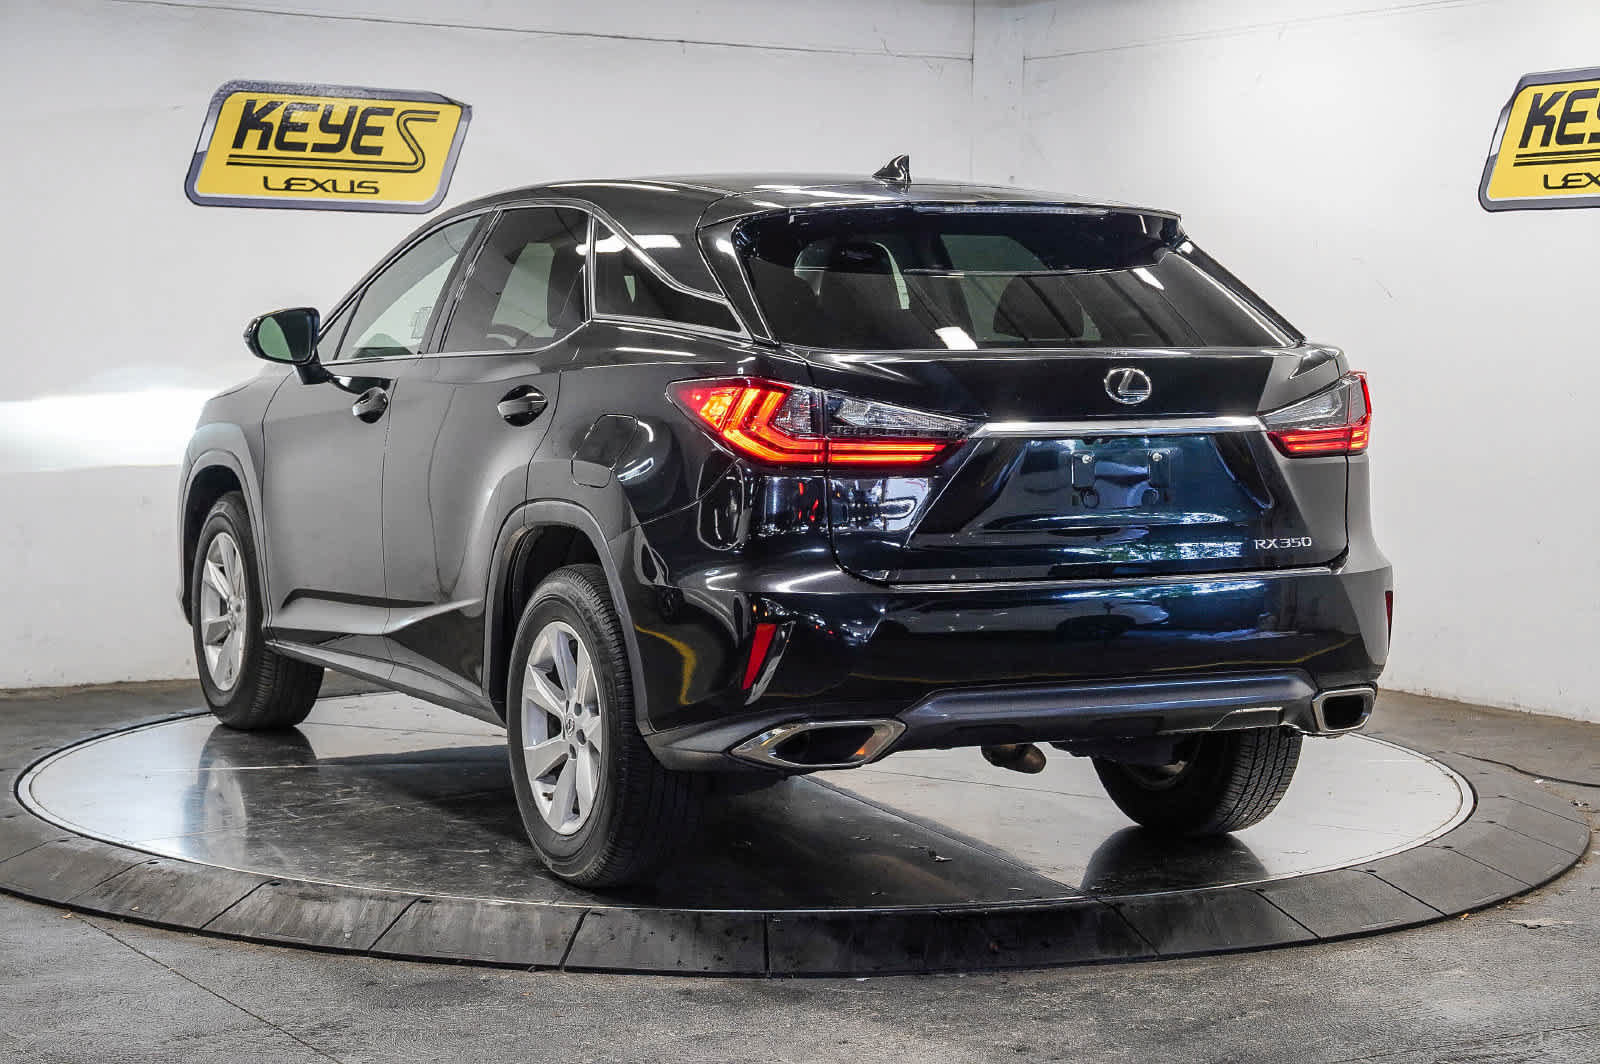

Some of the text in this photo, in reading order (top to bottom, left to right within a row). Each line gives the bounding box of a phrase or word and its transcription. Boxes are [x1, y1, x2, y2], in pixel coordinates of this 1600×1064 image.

[231, 99, 441, 172] KEYES
[1518, 88, 1600, 148] KE
[263, 175, 379, 194] LEXUS
